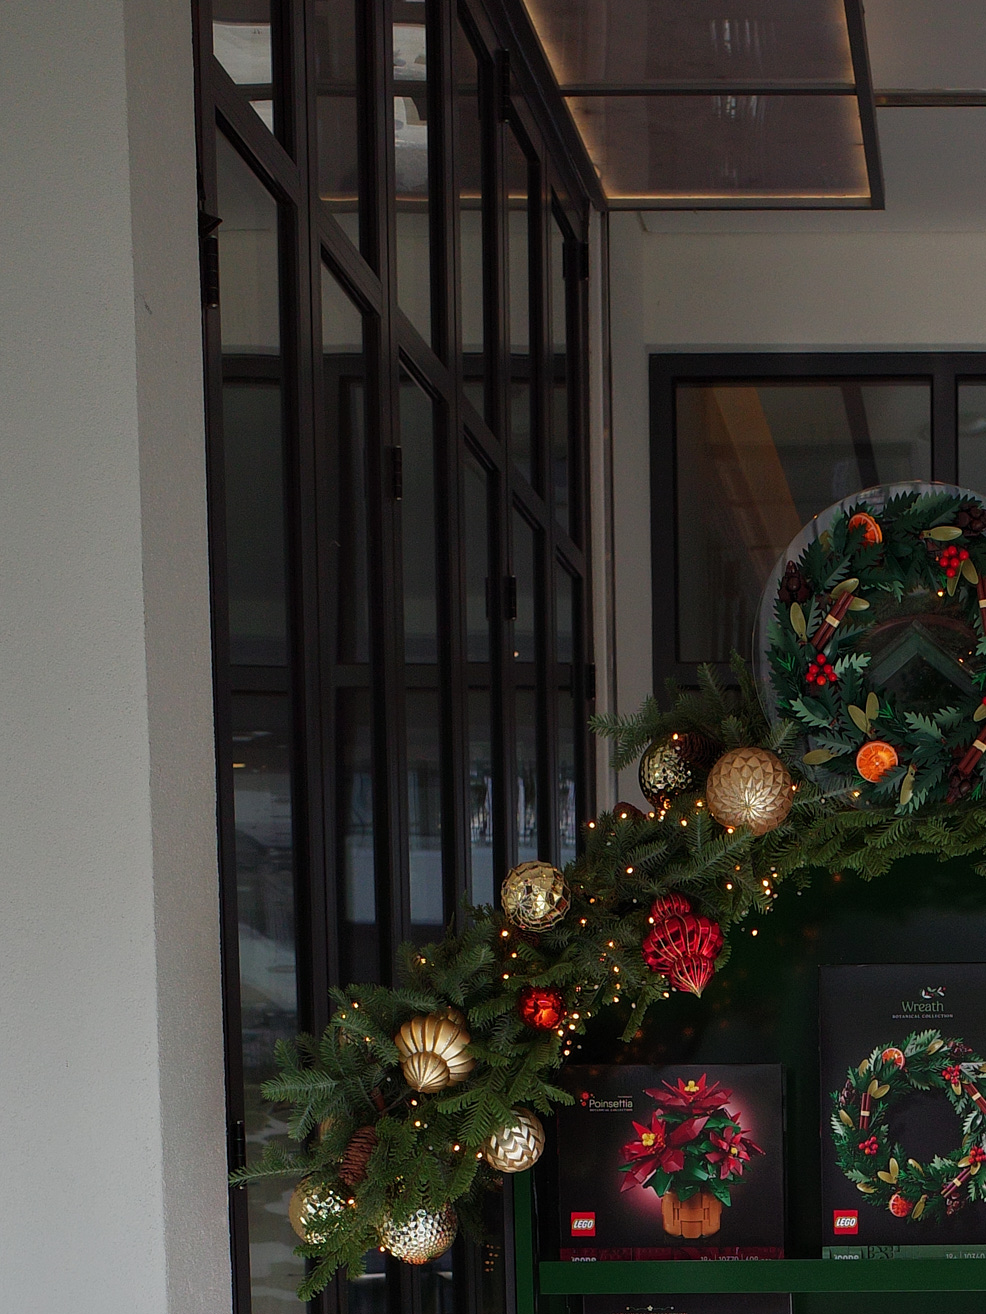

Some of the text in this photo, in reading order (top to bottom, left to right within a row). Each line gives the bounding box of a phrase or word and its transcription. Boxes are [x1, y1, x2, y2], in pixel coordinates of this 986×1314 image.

[902, 1001, 944, 1012] Wreath
[589, 1099, 633, 1108] Poinsettia
[572, 1219, 594, 1229] LEGO
[836, 1217, 857, 1227] LEGO
